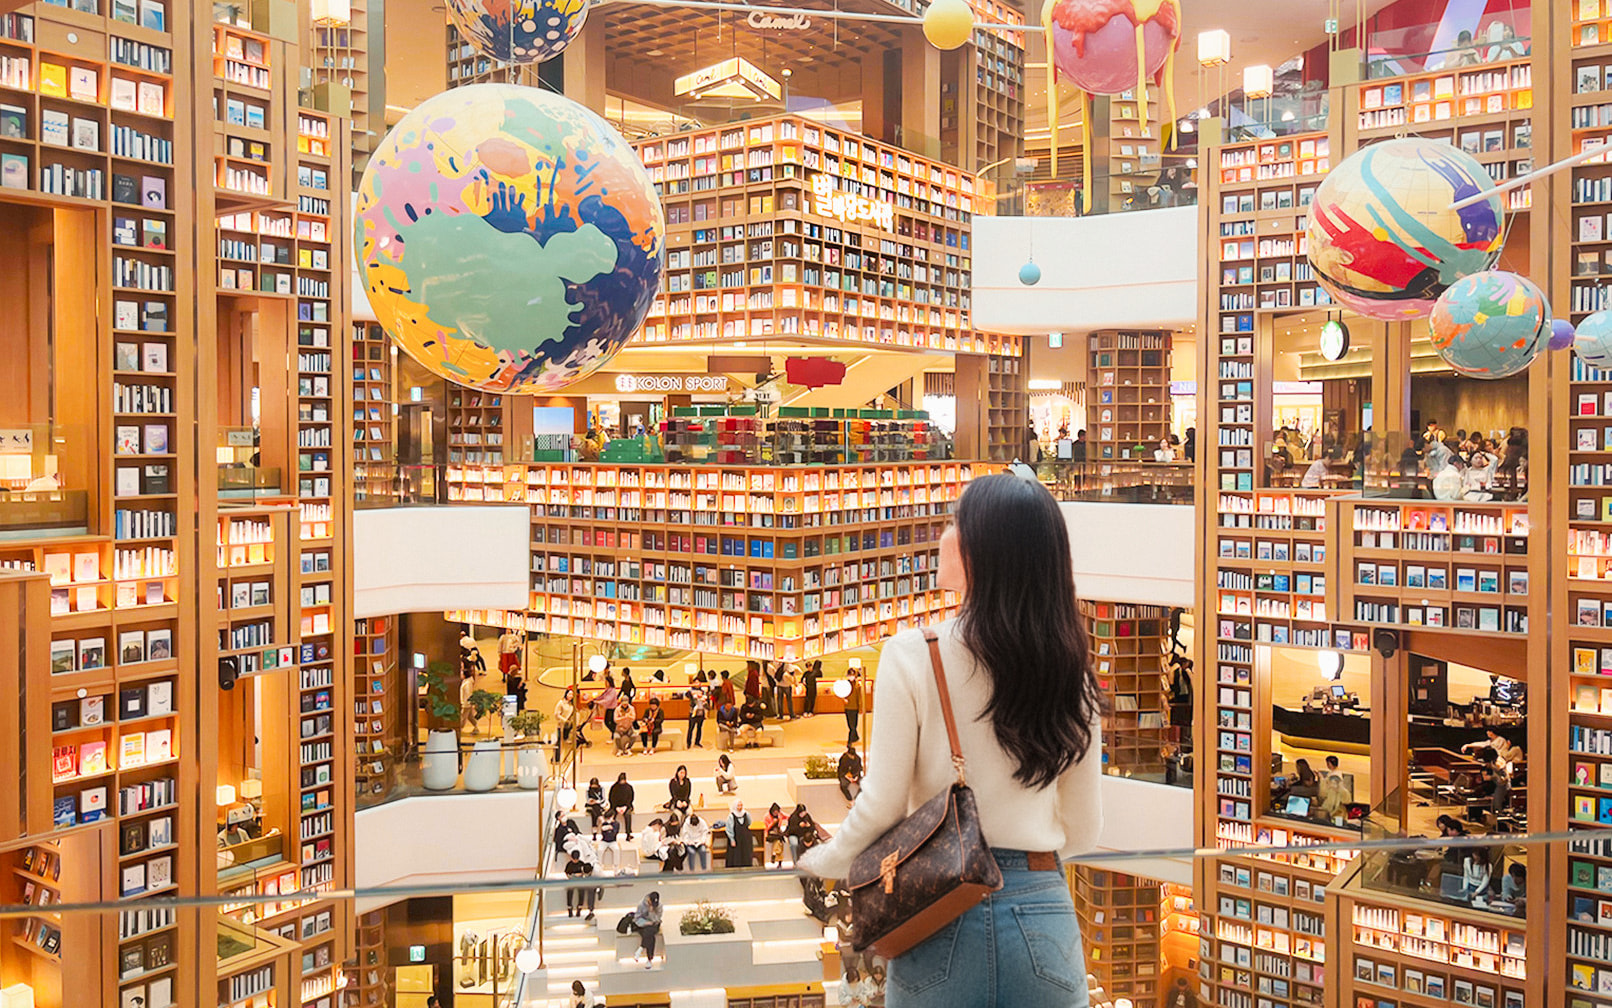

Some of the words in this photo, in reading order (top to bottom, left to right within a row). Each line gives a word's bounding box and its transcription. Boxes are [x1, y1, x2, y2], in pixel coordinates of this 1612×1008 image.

[747, 10, 811, 29] Camel
[810, 174, 894, 233] 별마당도서관
[636, 376, 682, 390] KOLON
[686, 376, 728, 390] SPORT
